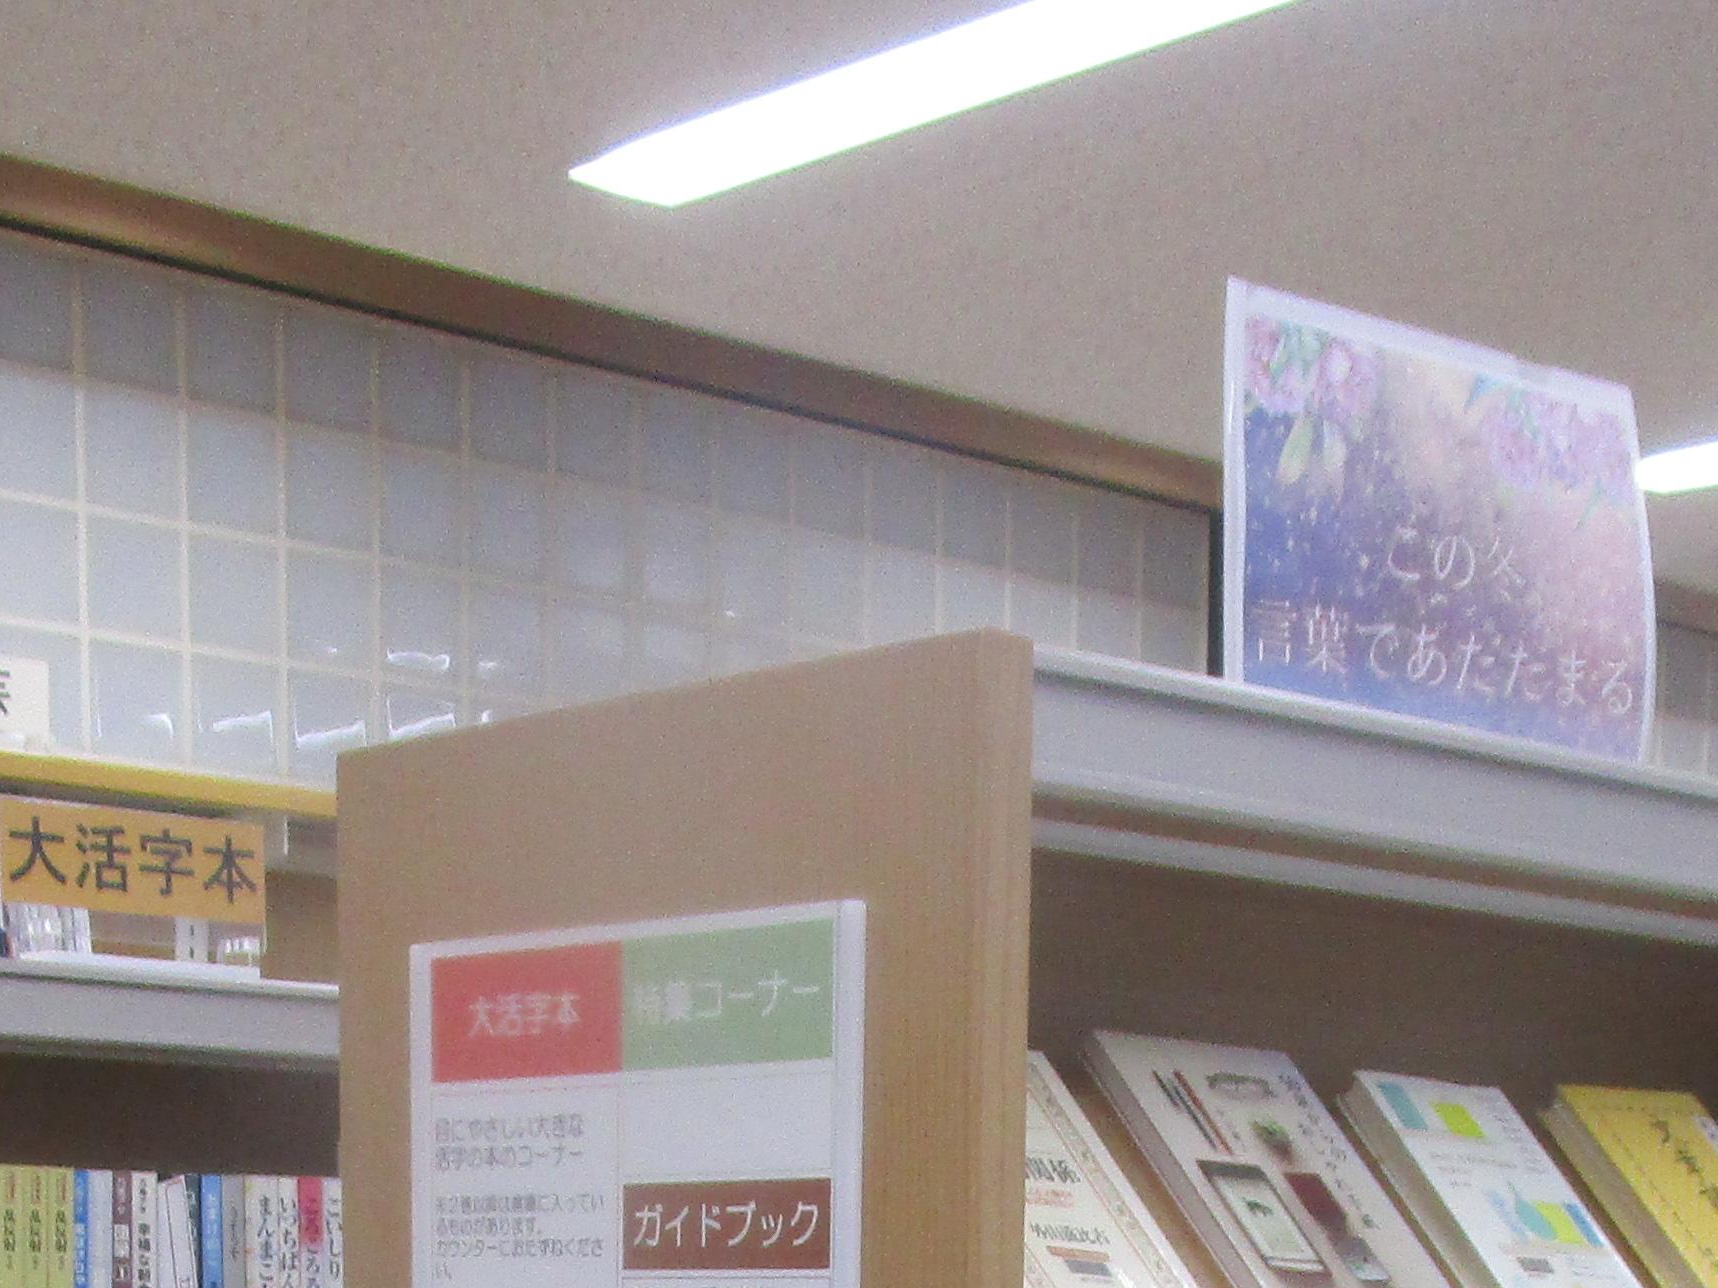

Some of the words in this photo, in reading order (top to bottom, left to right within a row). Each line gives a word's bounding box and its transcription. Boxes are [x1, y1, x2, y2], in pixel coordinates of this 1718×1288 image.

[8, 815, 257, 904] 大活字本
[633, 1201, 820, 1249] ガイドブック
